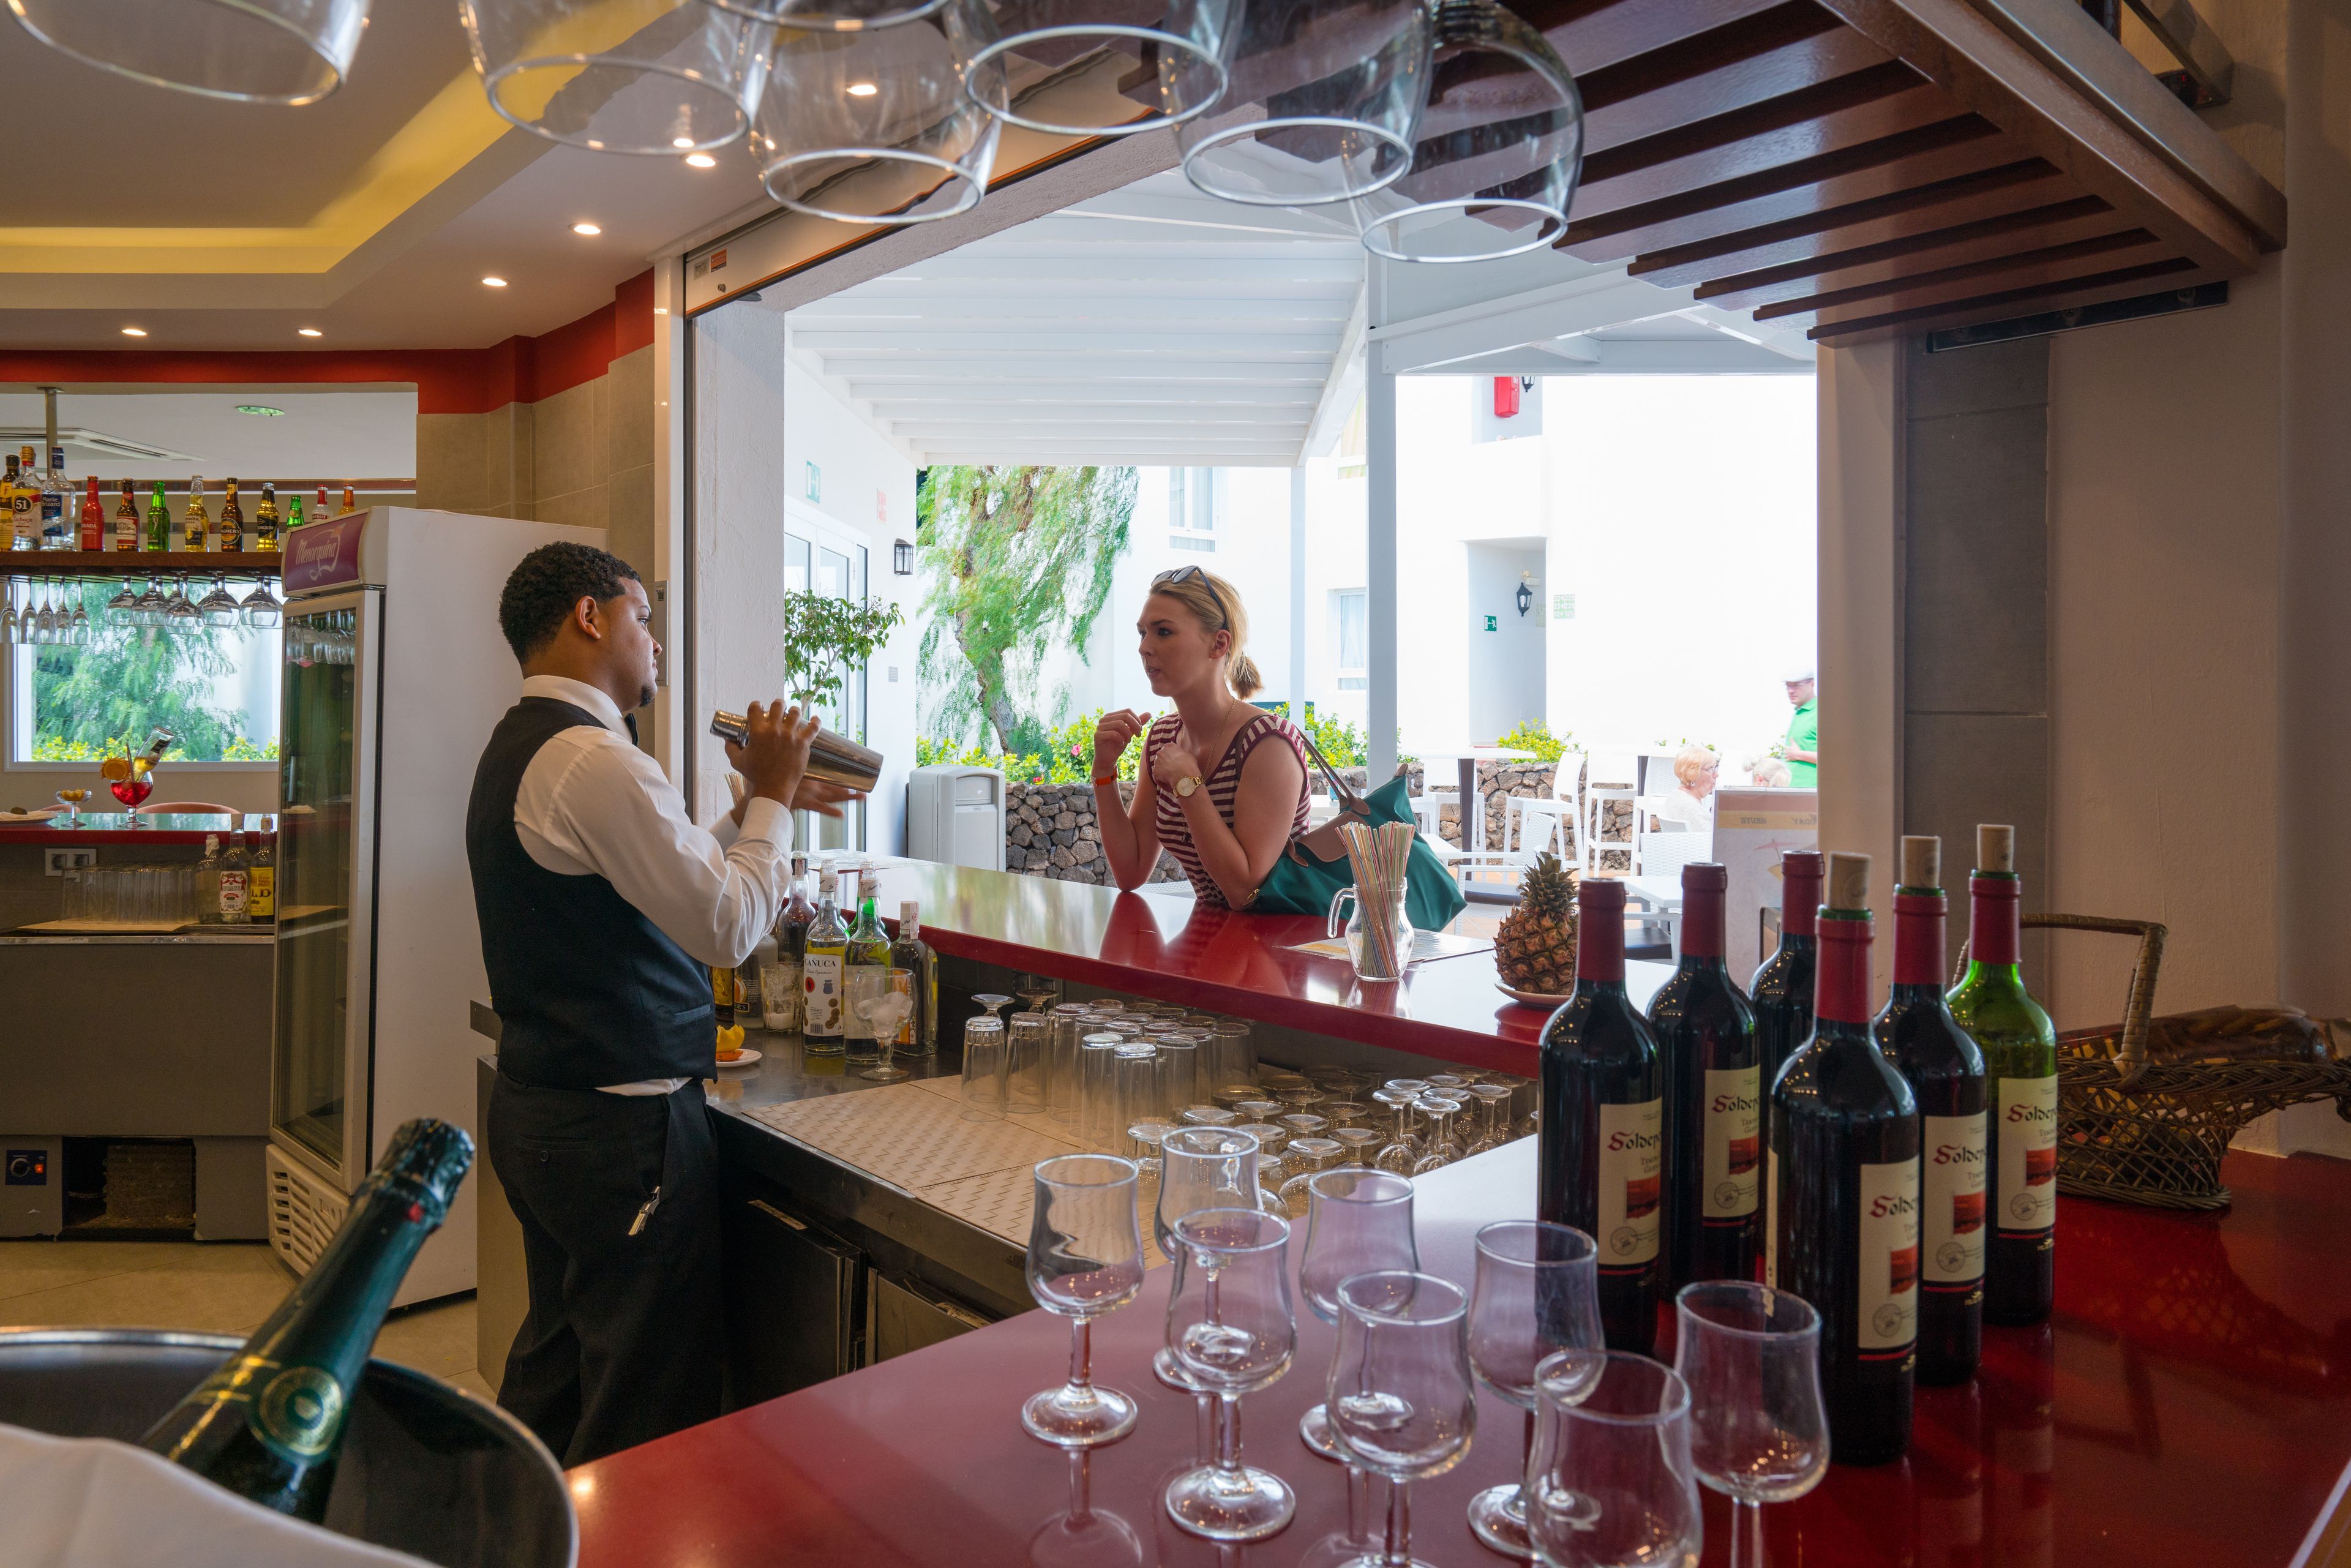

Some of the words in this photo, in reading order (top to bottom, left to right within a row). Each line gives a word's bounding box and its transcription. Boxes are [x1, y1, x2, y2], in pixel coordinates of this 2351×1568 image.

[15, 499, 28, 509] 51
[296, 539, 340, 576] Menorquina
[804, 958, 836, 967] CAÑUCA
